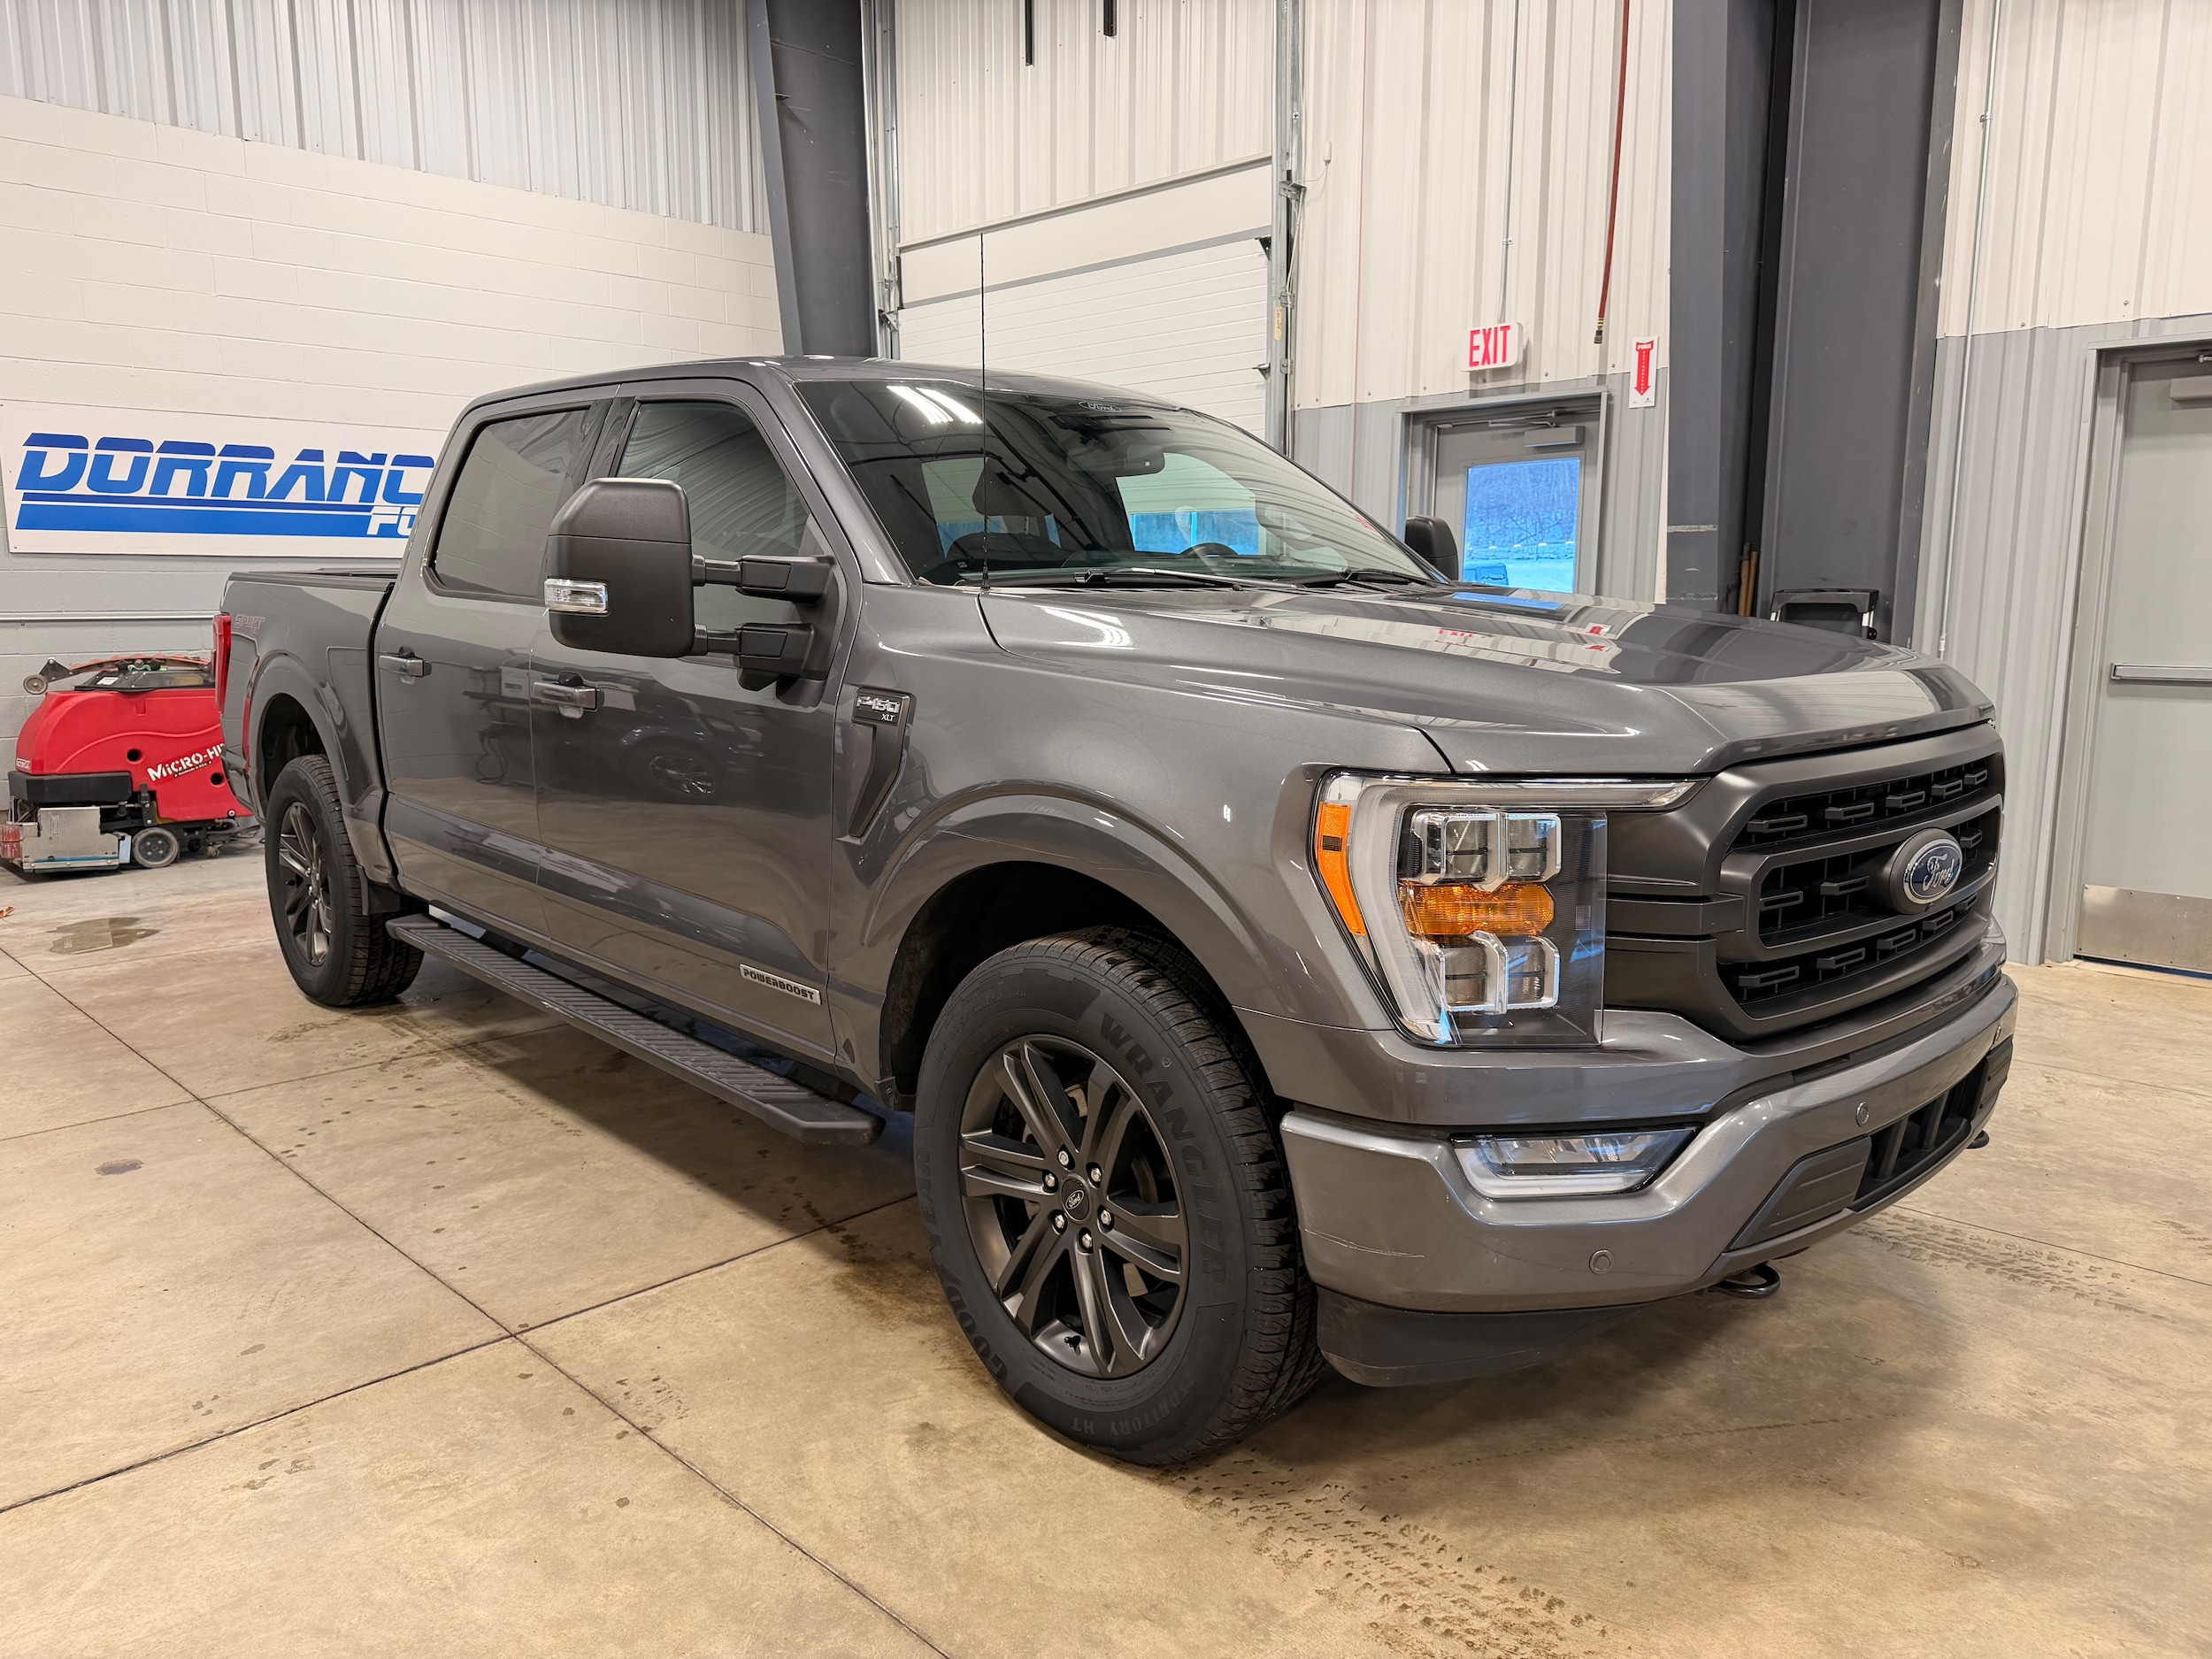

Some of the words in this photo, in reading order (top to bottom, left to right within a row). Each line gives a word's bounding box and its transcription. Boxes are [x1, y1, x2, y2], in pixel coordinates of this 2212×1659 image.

[1469, 325, 1510, 367] EXIT
[234, 614, 265, 629] SPORT
[856, 696, 901, 713] F-150
[1922, 853, 1955, 891] Ford
[743, 968, 814, 1000] POWERBOOST
[1099, 1011, 1226, 1284] WRANGLER
[1071, 1417, 1094, 1436] HT
